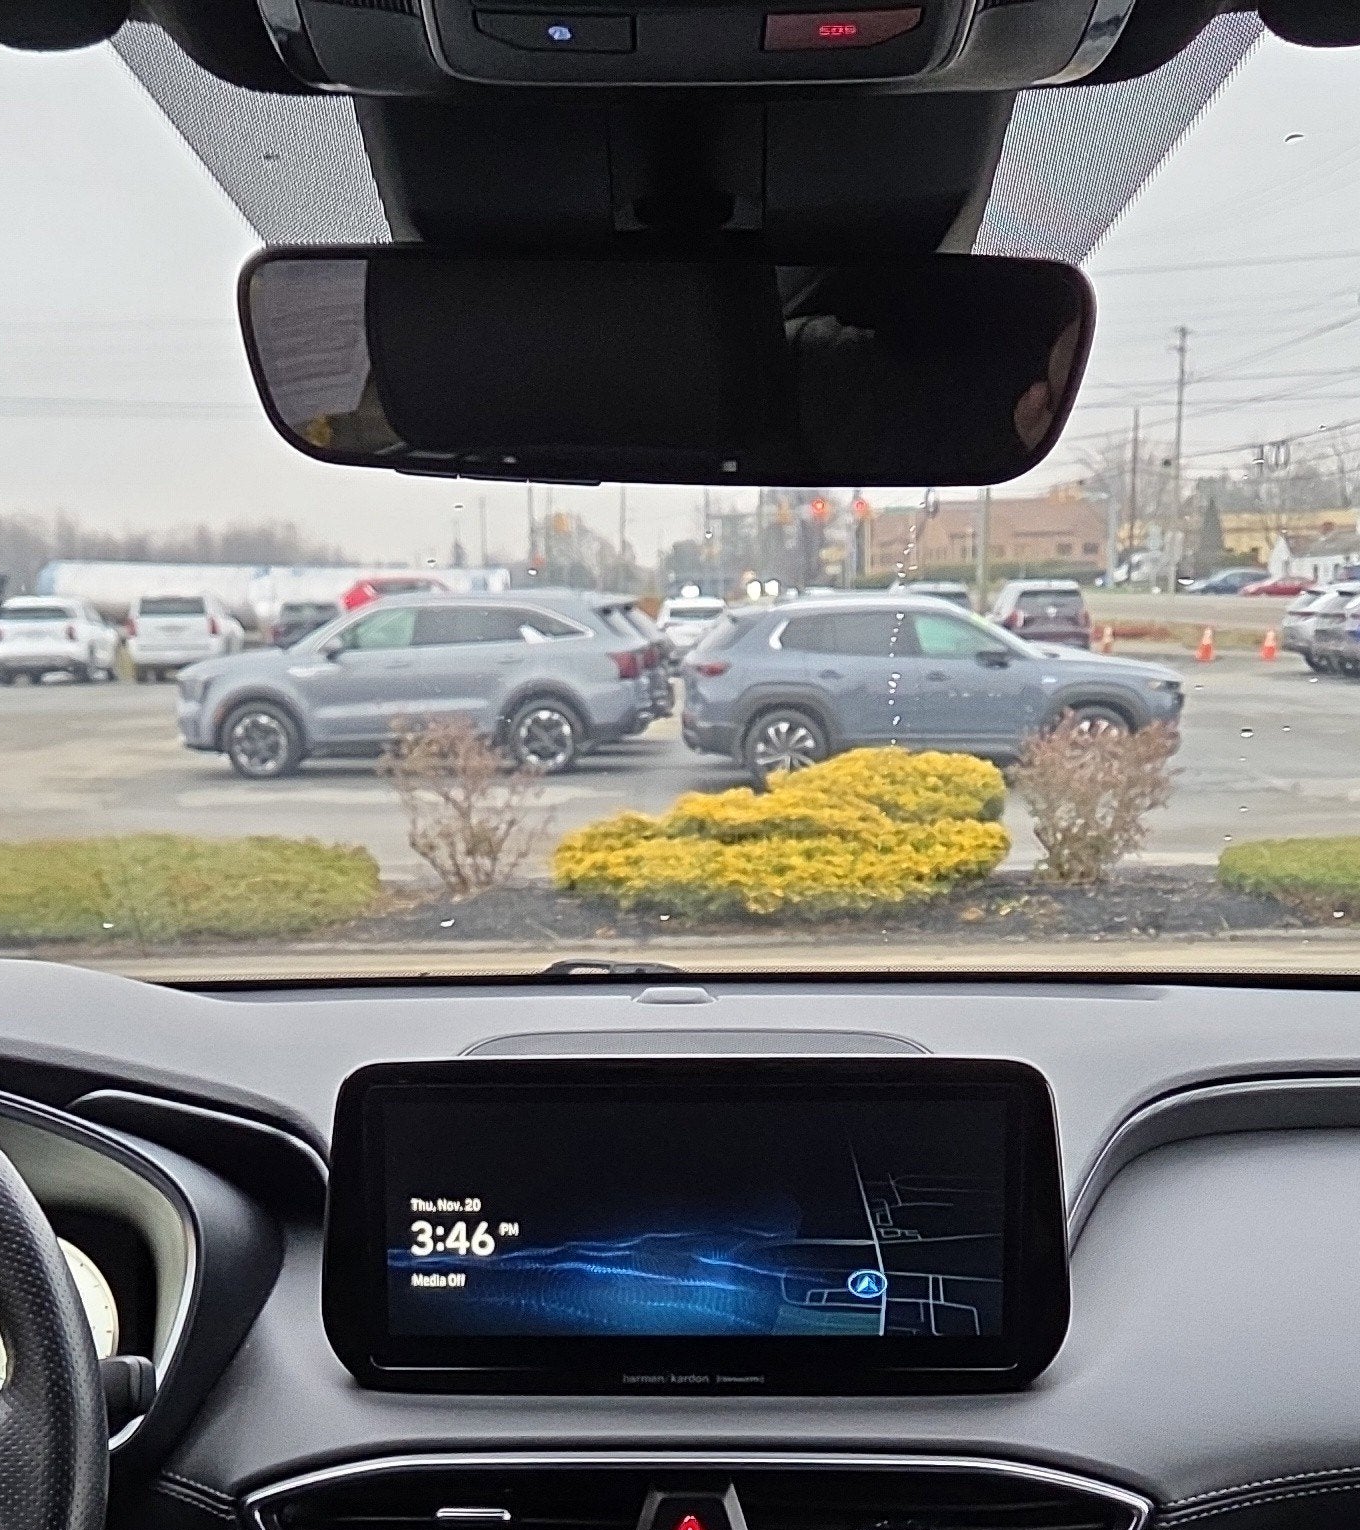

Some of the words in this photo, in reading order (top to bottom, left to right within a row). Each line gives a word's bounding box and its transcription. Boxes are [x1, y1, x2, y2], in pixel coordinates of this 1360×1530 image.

[410, 1198, 436, 1212] Thu,
[437, 1198, 463, 1212] Nov.
[464, 1198, 481, 1212] 20
[410, 1220, 495, 1256] 3:46
[499, 1221, 519, 1236] PM
[411, 1273, 446, 1287] Media
[447, 1273, 466, 1287] Off
